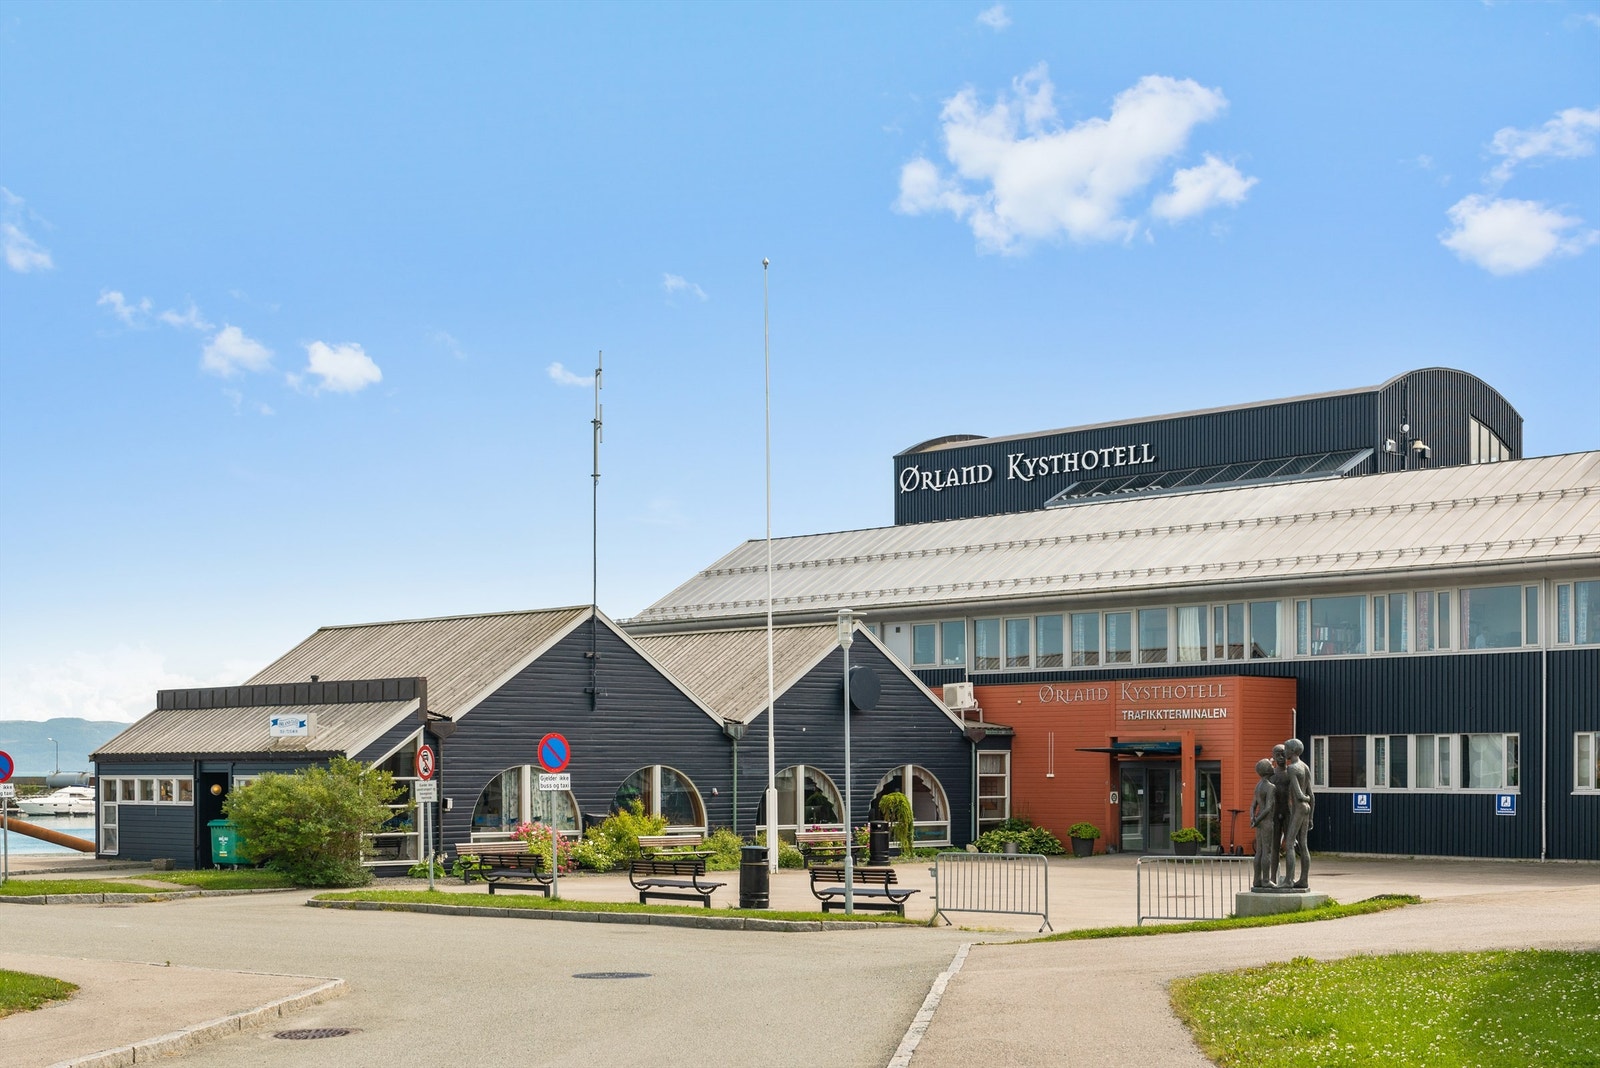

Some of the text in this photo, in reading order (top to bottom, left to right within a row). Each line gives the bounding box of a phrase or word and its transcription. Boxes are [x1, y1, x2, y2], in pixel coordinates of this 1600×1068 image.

[899, 443, 1155, 494] ØRLAND KYSTHOTELL
[1039, 682, 1226, 704] ØRLAND KYSTHOTELL
[1122, 708, 1227, 720] TRAFIKKTERMINALEN
